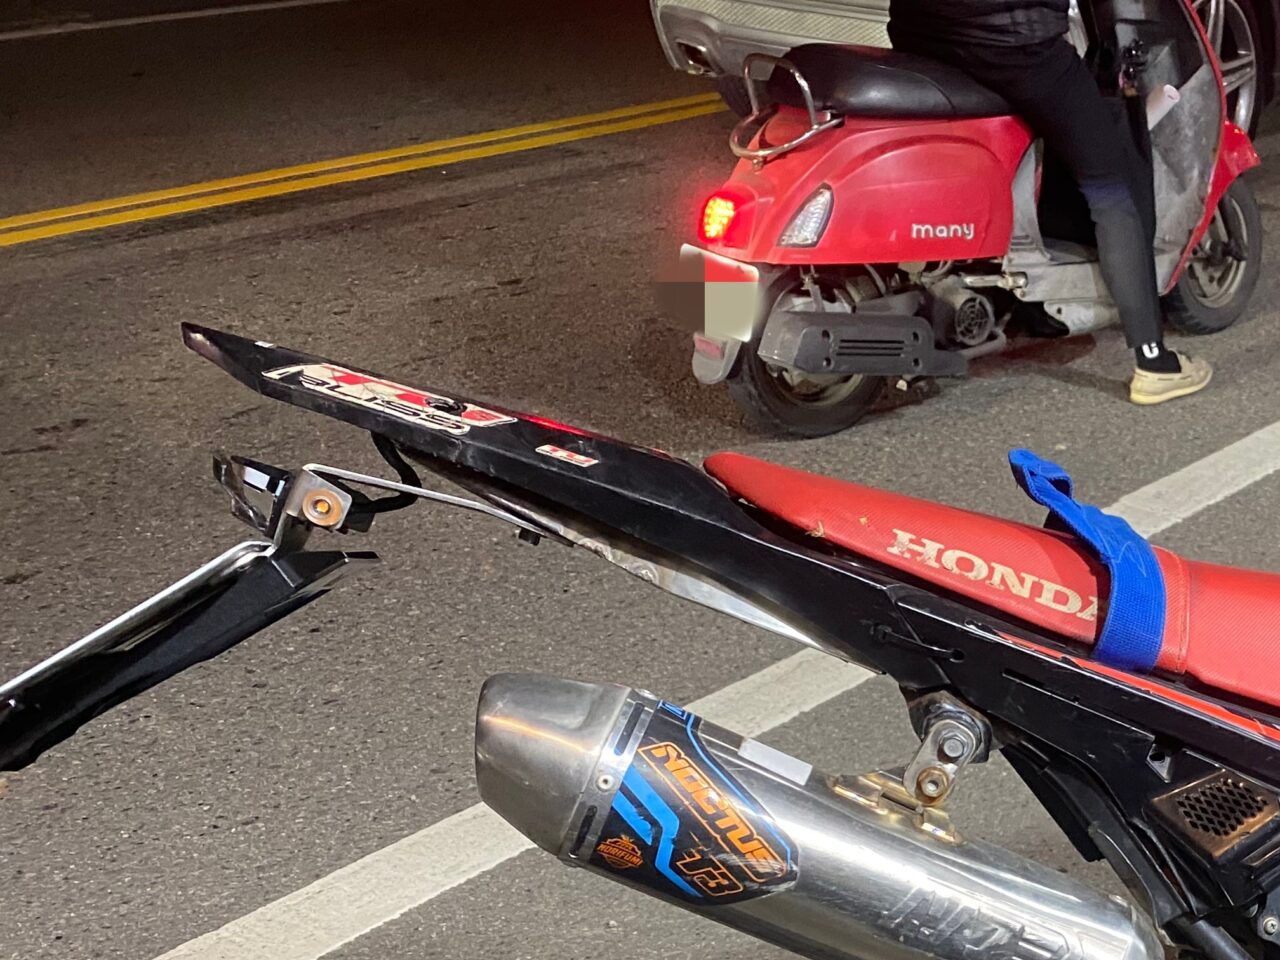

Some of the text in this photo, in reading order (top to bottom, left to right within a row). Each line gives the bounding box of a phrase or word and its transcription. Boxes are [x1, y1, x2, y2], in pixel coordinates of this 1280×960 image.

[911, 222, 975, 240] many
[885, 528, 1108, 622] HONDA
[649, 743, 786, 877] NOCTUS
[677, 847, 744, 896] T3
